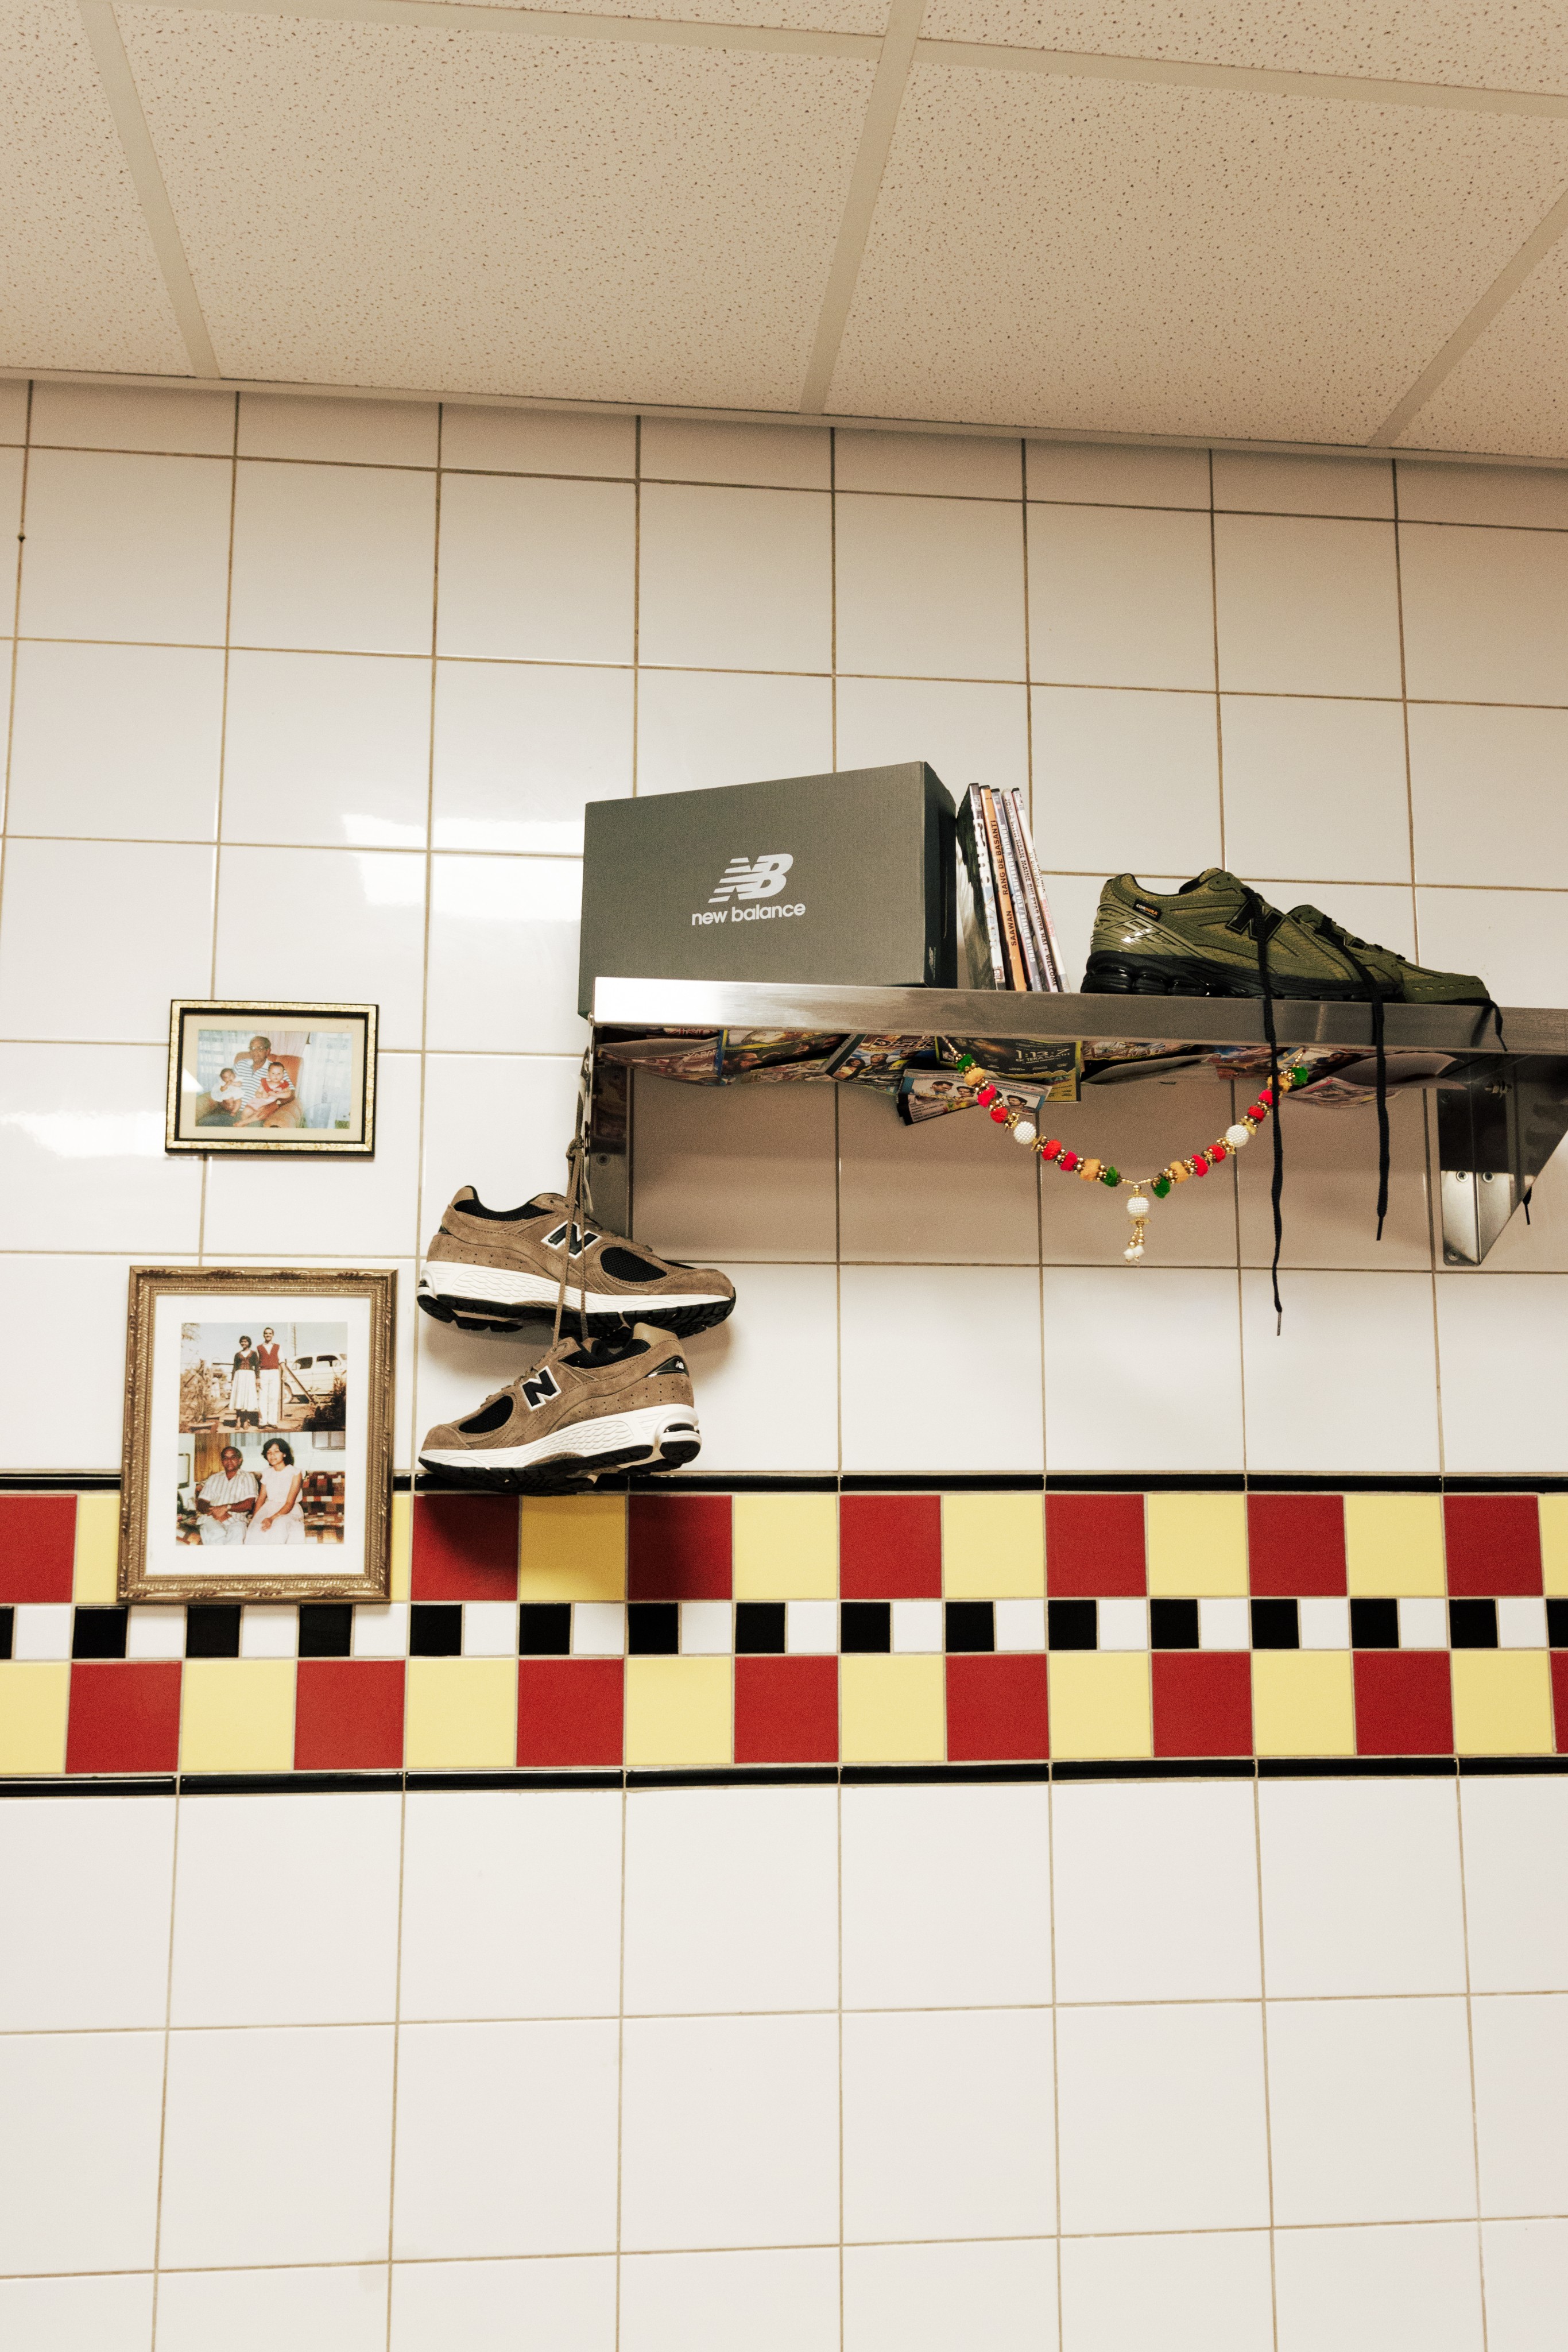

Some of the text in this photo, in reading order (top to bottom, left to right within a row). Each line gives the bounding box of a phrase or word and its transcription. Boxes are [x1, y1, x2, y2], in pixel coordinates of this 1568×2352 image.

[990, 820, 1017, 946] SAAWAN RANG DE BASANTI
[1007, 854, 1019, 891] SUPERKOOL
[1015, 891, 1024, 908] KYAA
[1136, 904, 1158, 916] CORDURA
[692, 903, 806, 926] new balance
[1021, 860, 1031, 882] MAINE
[1031, 897, 1040, 914] PYAR
[1036, 915, 1044, 931] KIYA
[1045, 953, 1056, 987] WELCOME
[1021, 914, 1031, 938] DRIVER
[1025, 938, 1036, 962] CHALLO
